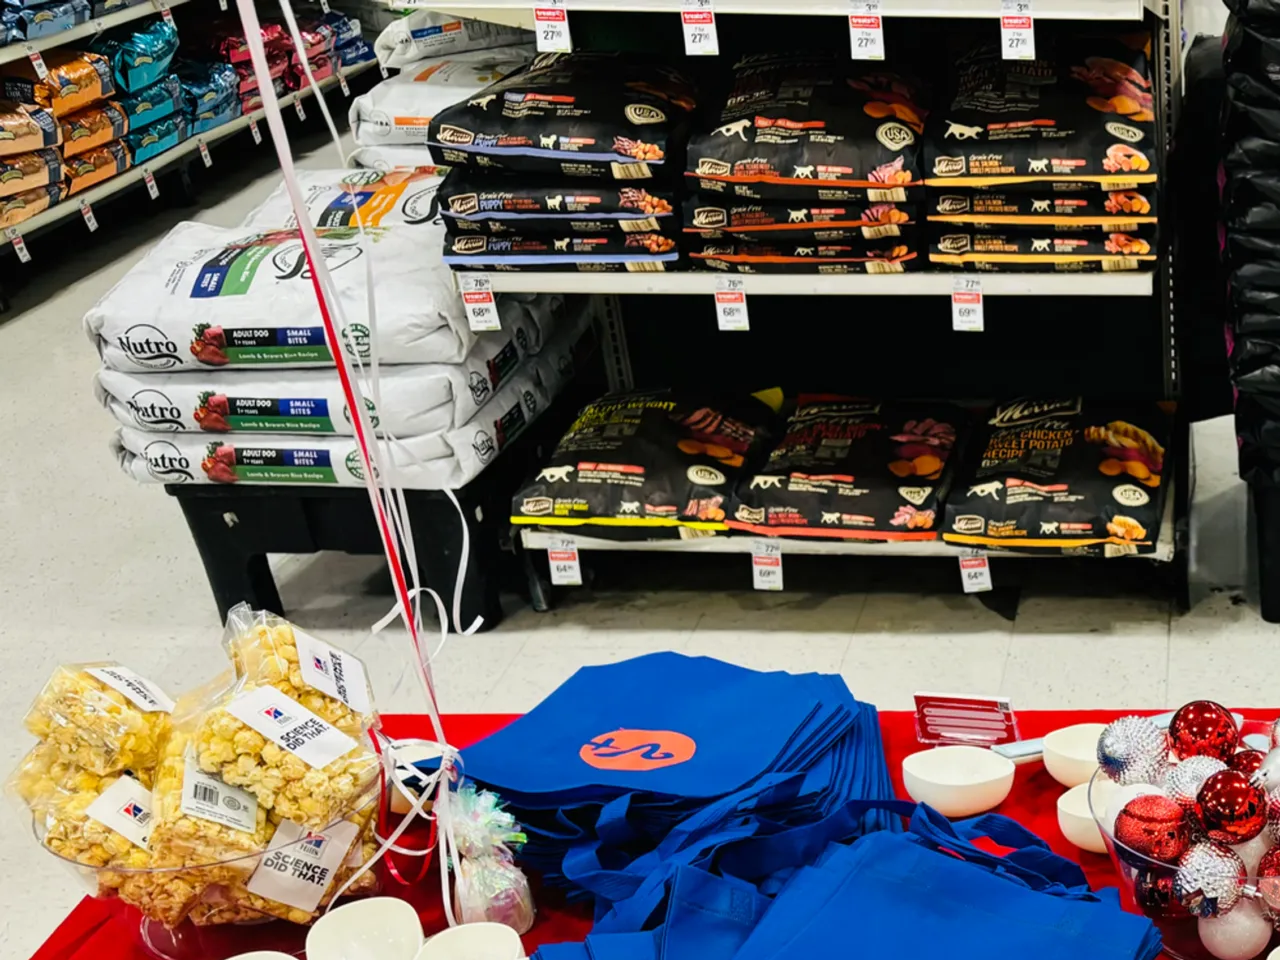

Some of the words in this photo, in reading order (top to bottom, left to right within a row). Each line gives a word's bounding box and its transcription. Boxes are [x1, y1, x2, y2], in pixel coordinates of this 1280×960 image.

[887, 130, 909, 141] USA
[233, 330, 255, 338] ADULT
[256, 330, 269, 338] DOG
[286, 329, 311, 337] SMALL
[118, 337, 178, 354] Nutro
[236, 399, 255, 407] ADULT
[257, 399, 271, 407] DOG
[290, 399, 315, 408] SMALL
[290, 407, 311, 415] BITES
[1020, 430, 1073, 440] CHICKEN
[242, 450, 262, 458] ADULT
[294, 450, 318, 458] SMALL
[143, 452, 190, 469] utro
[280, 717, 320, 743] SCIENCE
[287, 738, 305, 751] DID
[303, 724, 330, 741] THAT.
[272, 851, 330, 877] SCIENCE
[263, 858, 288, 873] DID
[290, 868, 326, 887] THAT.
